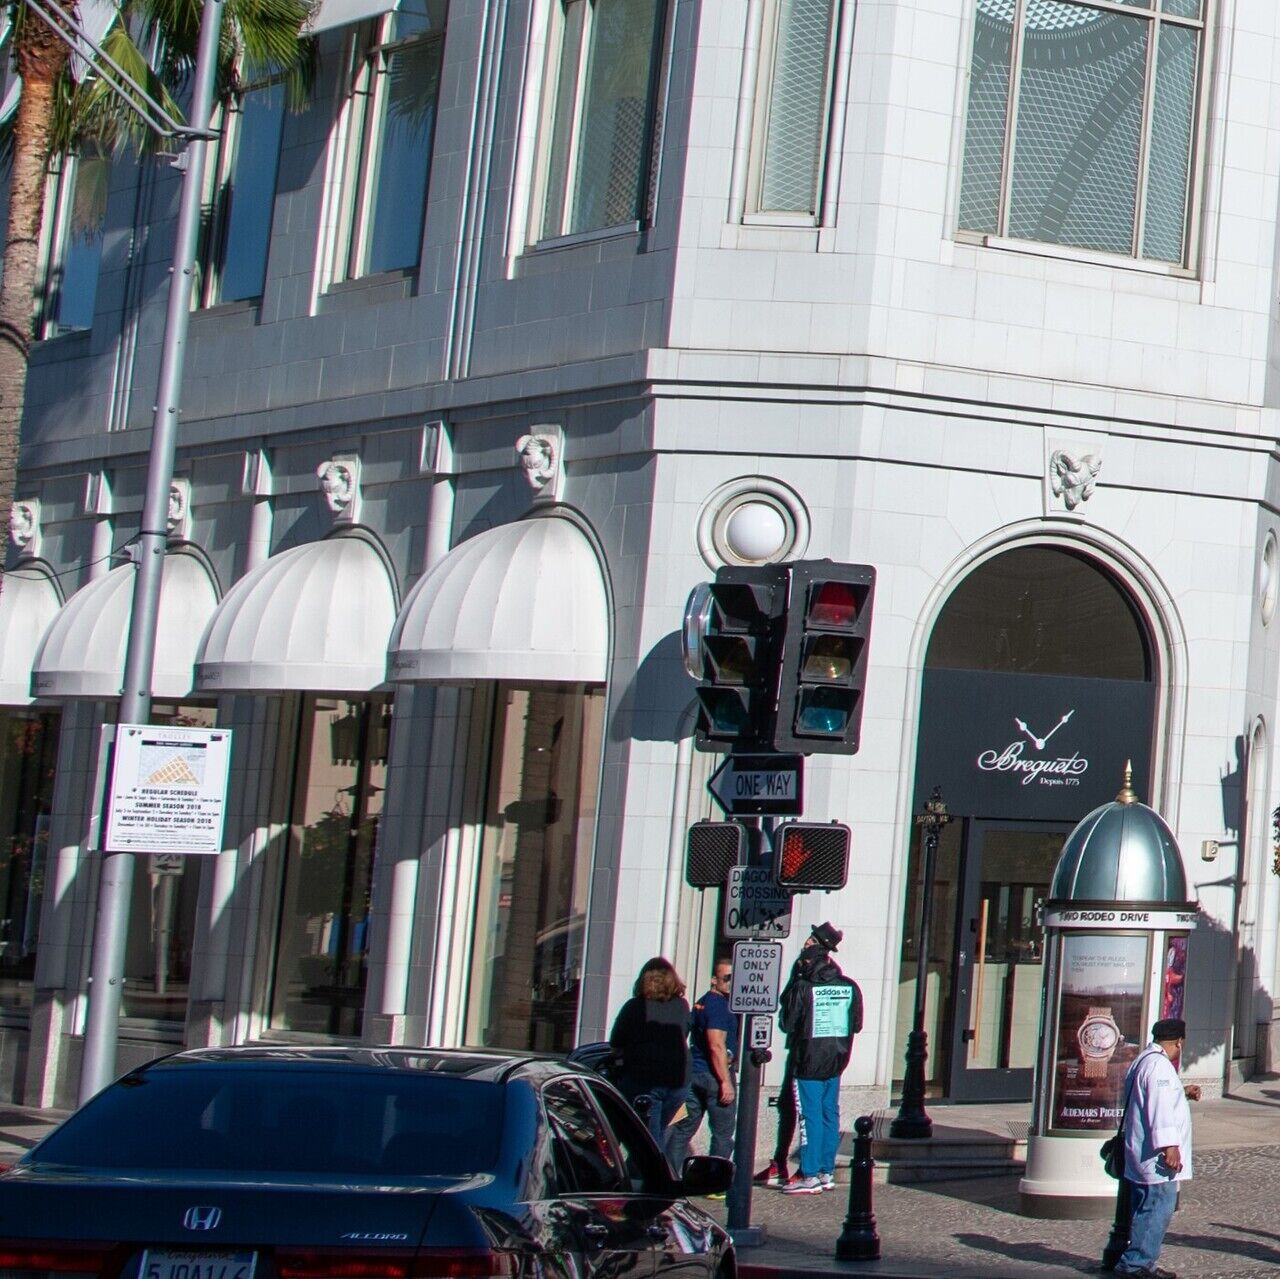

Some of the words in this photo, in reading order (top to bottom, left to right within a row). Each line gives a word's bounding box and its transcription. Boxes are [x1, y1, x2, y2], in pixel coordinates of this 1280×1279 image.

[977, 740, 1088, 785] Breguet
[736, 774, 761, 796] ONE
[766, 773, 792, 796] WAY
[1040, 777, 1064, 787] Depuis
[1065, 778, 1080, 786] 1775
[730, 885, 789, 900] CROSSING
[728, 907, 749, 930] OK
[1059, 911, 1079, 921] TWO
[1080, 912, 1116, 922] RODEO
[1120, 912, 1150, 922] DRIVE
[740, 948, 776, 959] CROSS
[744, 960, 771, 971] ONLY
[749, 972, 764, 982] ON
[740, 984, 770, 995] WALK
[815, 988, 841, 996] adidas
[734, 996, 774, 1007] SIGNAL
[1060, 1106, 1098, 1118] AUDEMARS
[1100, 1107, 1124, 1118] PIGUET
[340, 1232, 408, 1240] ACCORD
